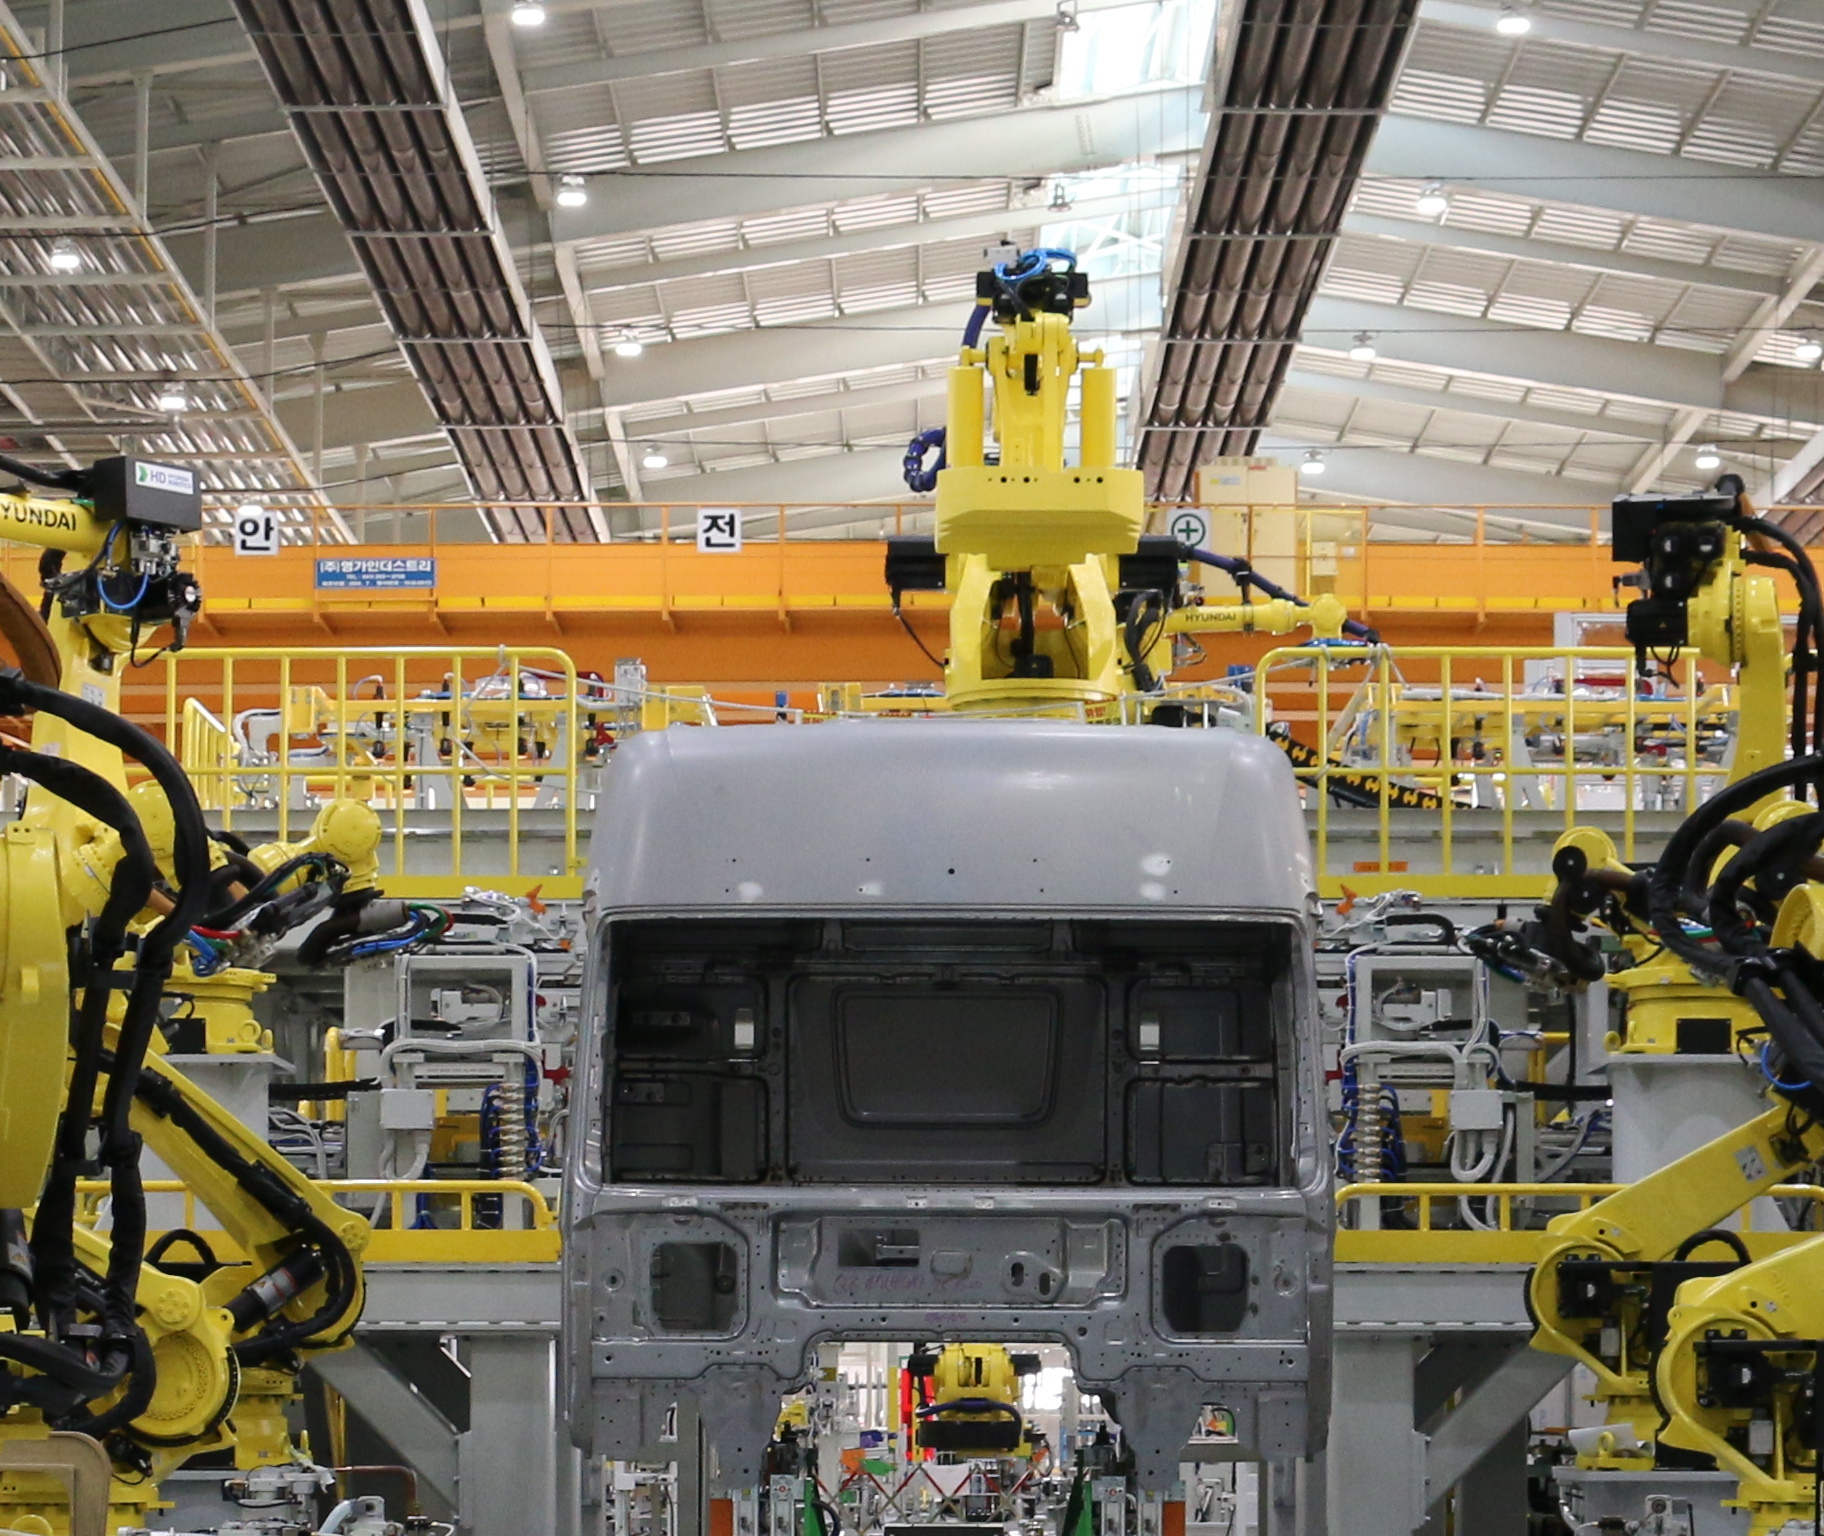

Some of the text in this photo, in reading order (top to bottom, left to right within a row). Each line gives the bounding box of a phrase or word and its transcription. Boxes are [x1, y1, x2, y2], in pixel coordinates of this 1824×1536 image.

[150, 470, 166, 484] HD
[239, 516, 274, 551] 안
[702, 513, 736, 548] 전
[1185, 613, 1236, 622] HYUNDAI
